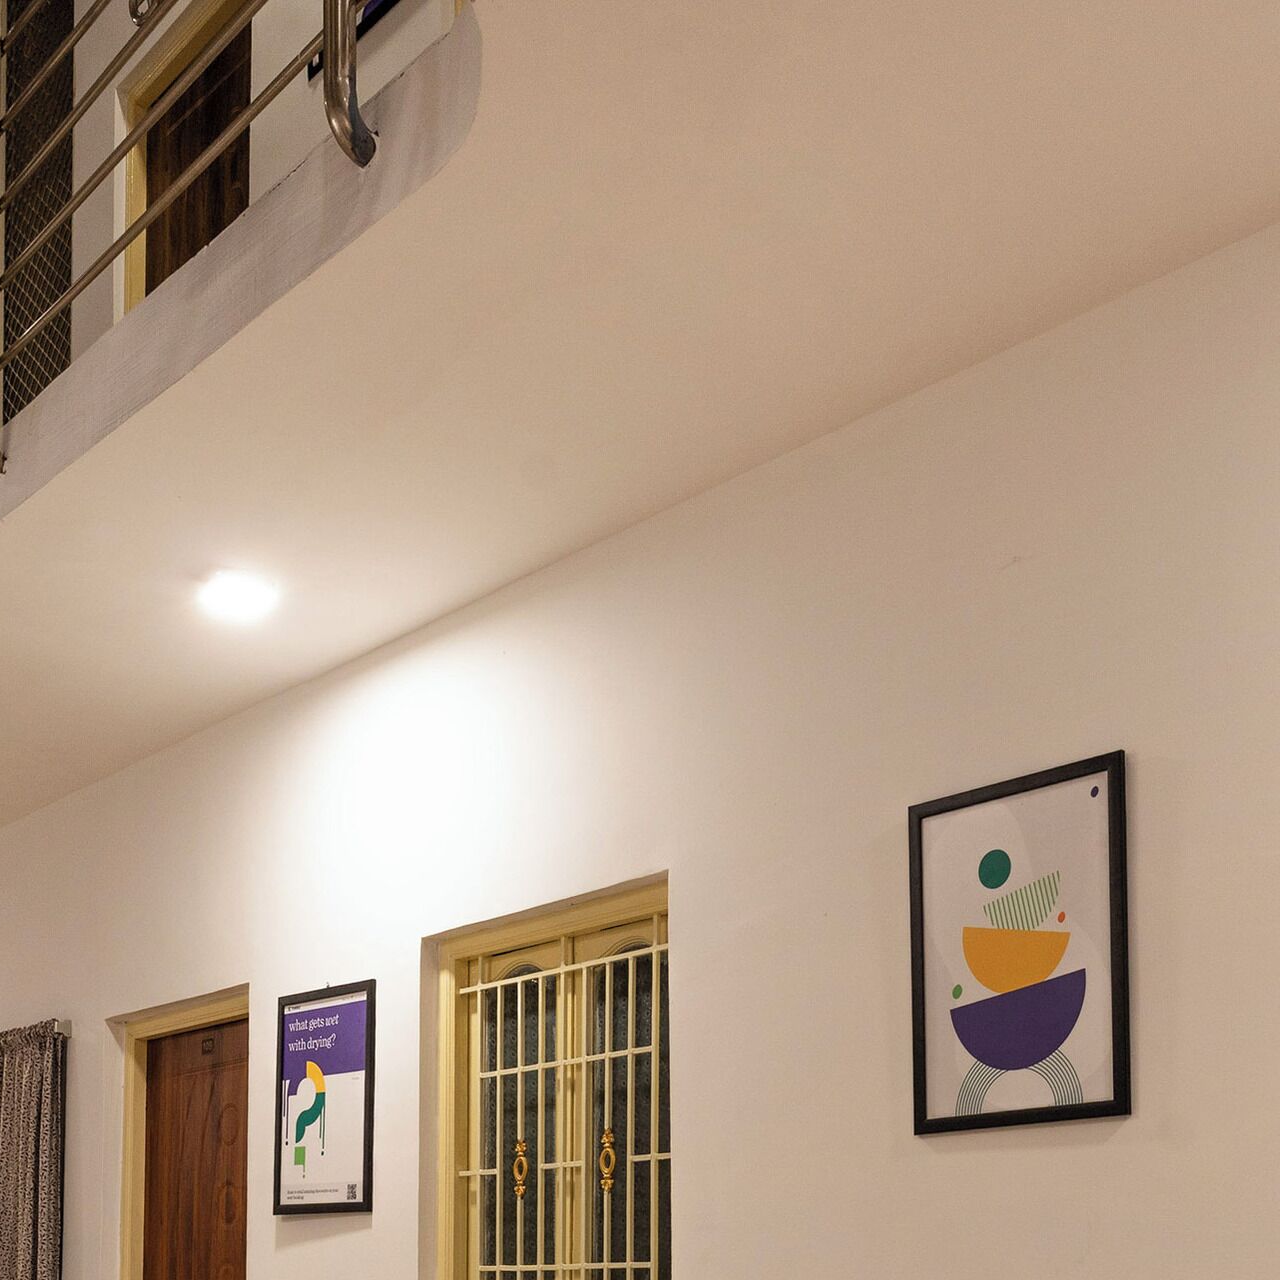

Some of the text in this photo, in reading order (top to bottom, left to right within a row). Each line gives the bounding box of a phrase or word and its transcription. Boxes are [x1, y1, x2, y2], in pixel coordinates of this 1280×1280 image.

[288, 1013, 340, 1032] what gets wet
[288, 1033, 337, 1052] with drying?
